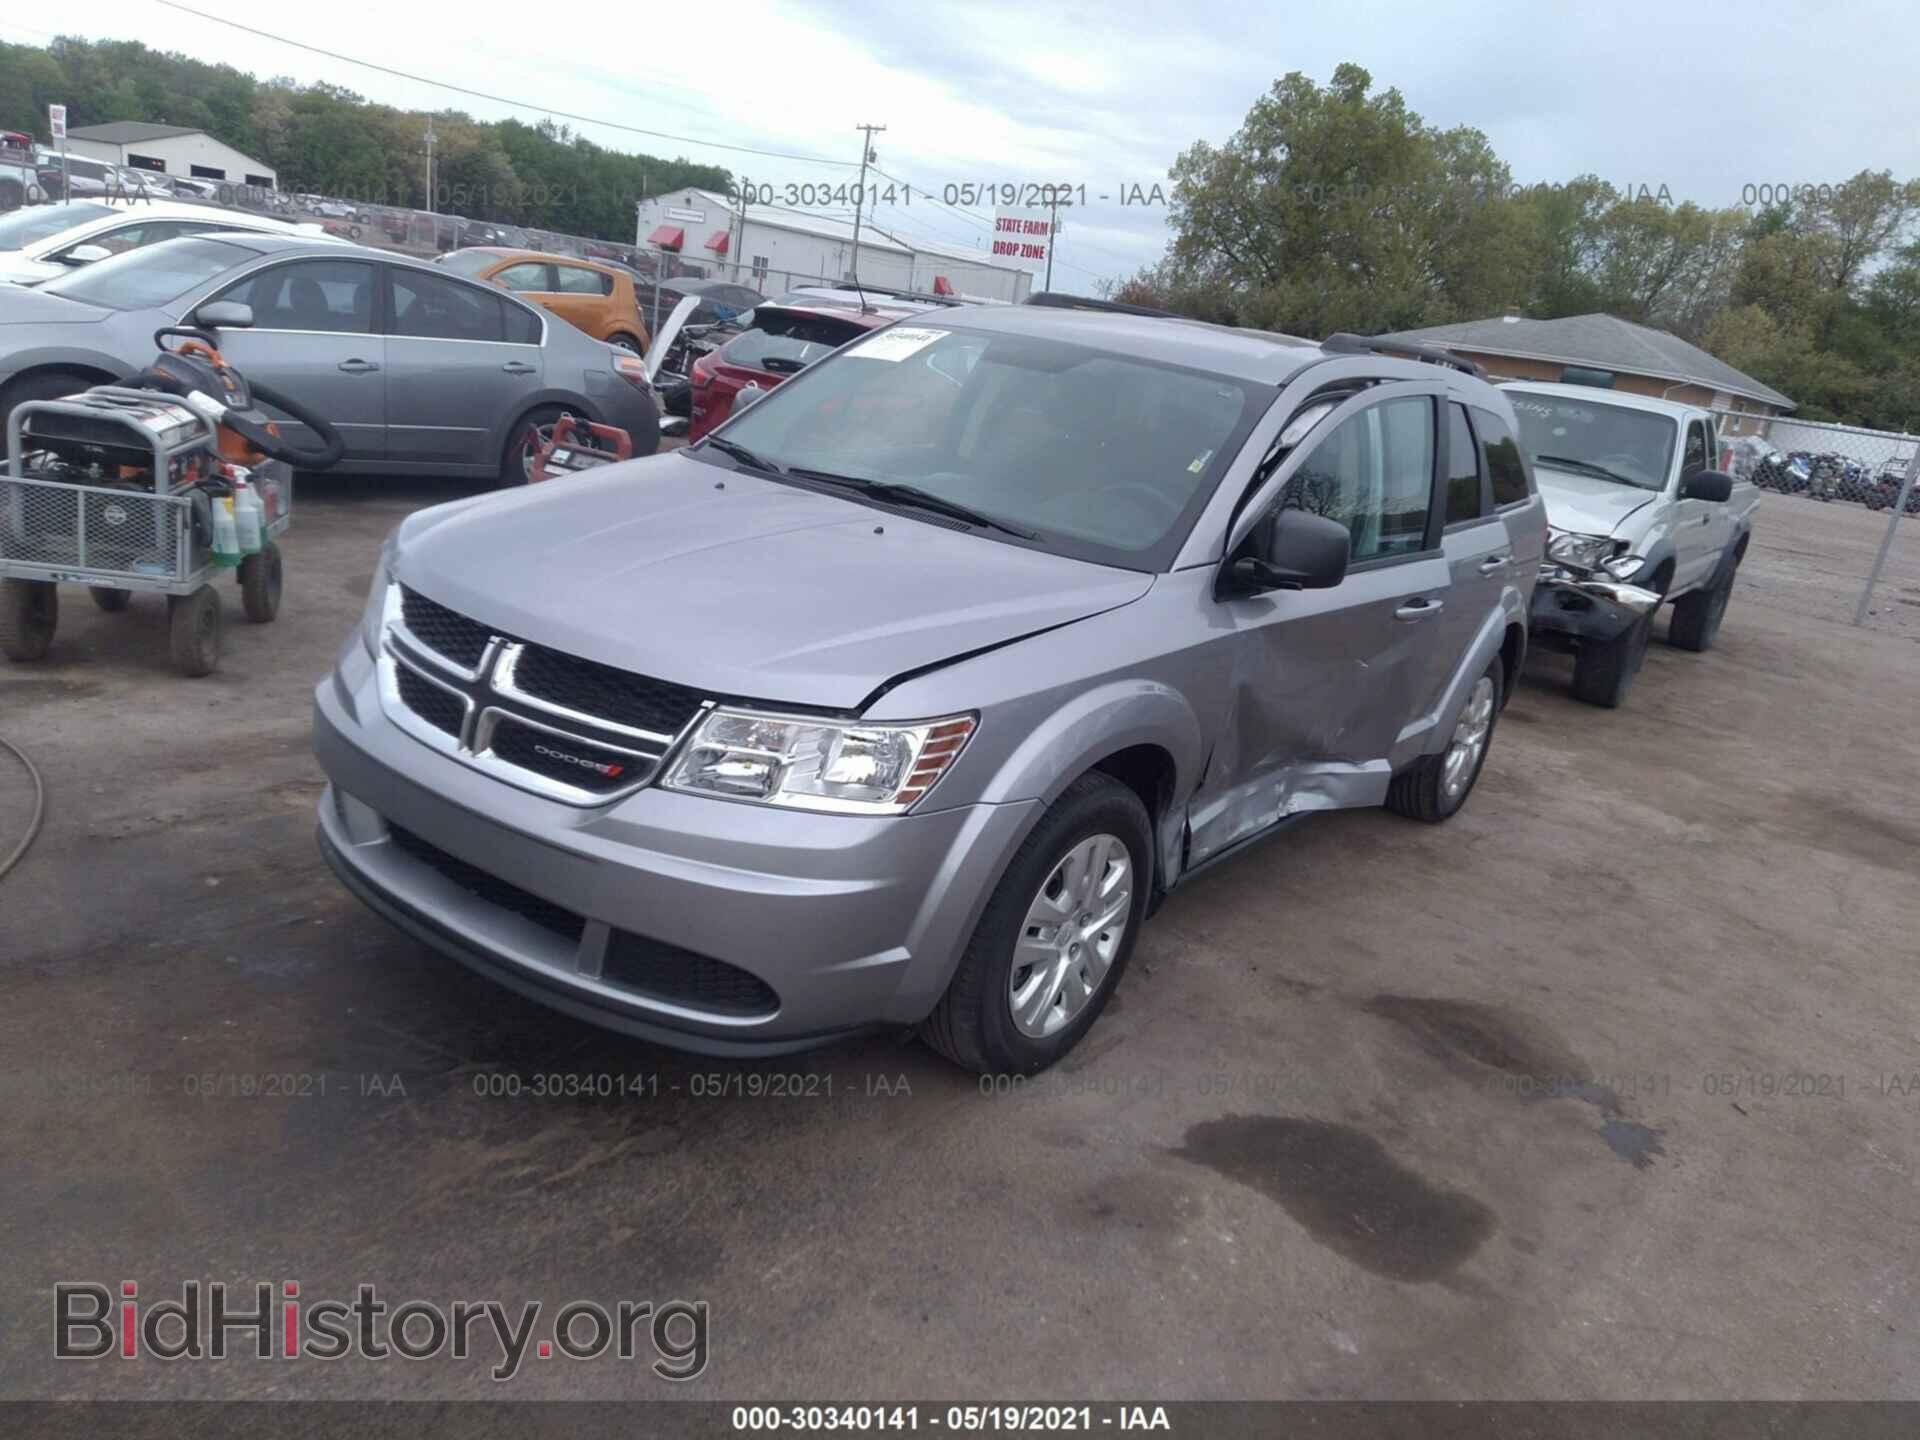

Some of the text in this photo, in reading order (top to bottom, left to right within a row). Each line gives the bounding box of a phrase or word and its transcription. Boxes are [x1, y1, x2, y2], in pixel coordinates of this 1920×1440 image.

[995, 217, 1049, 236] STATE FARM
[992, 240, 1046, 260] DROP ZONE
